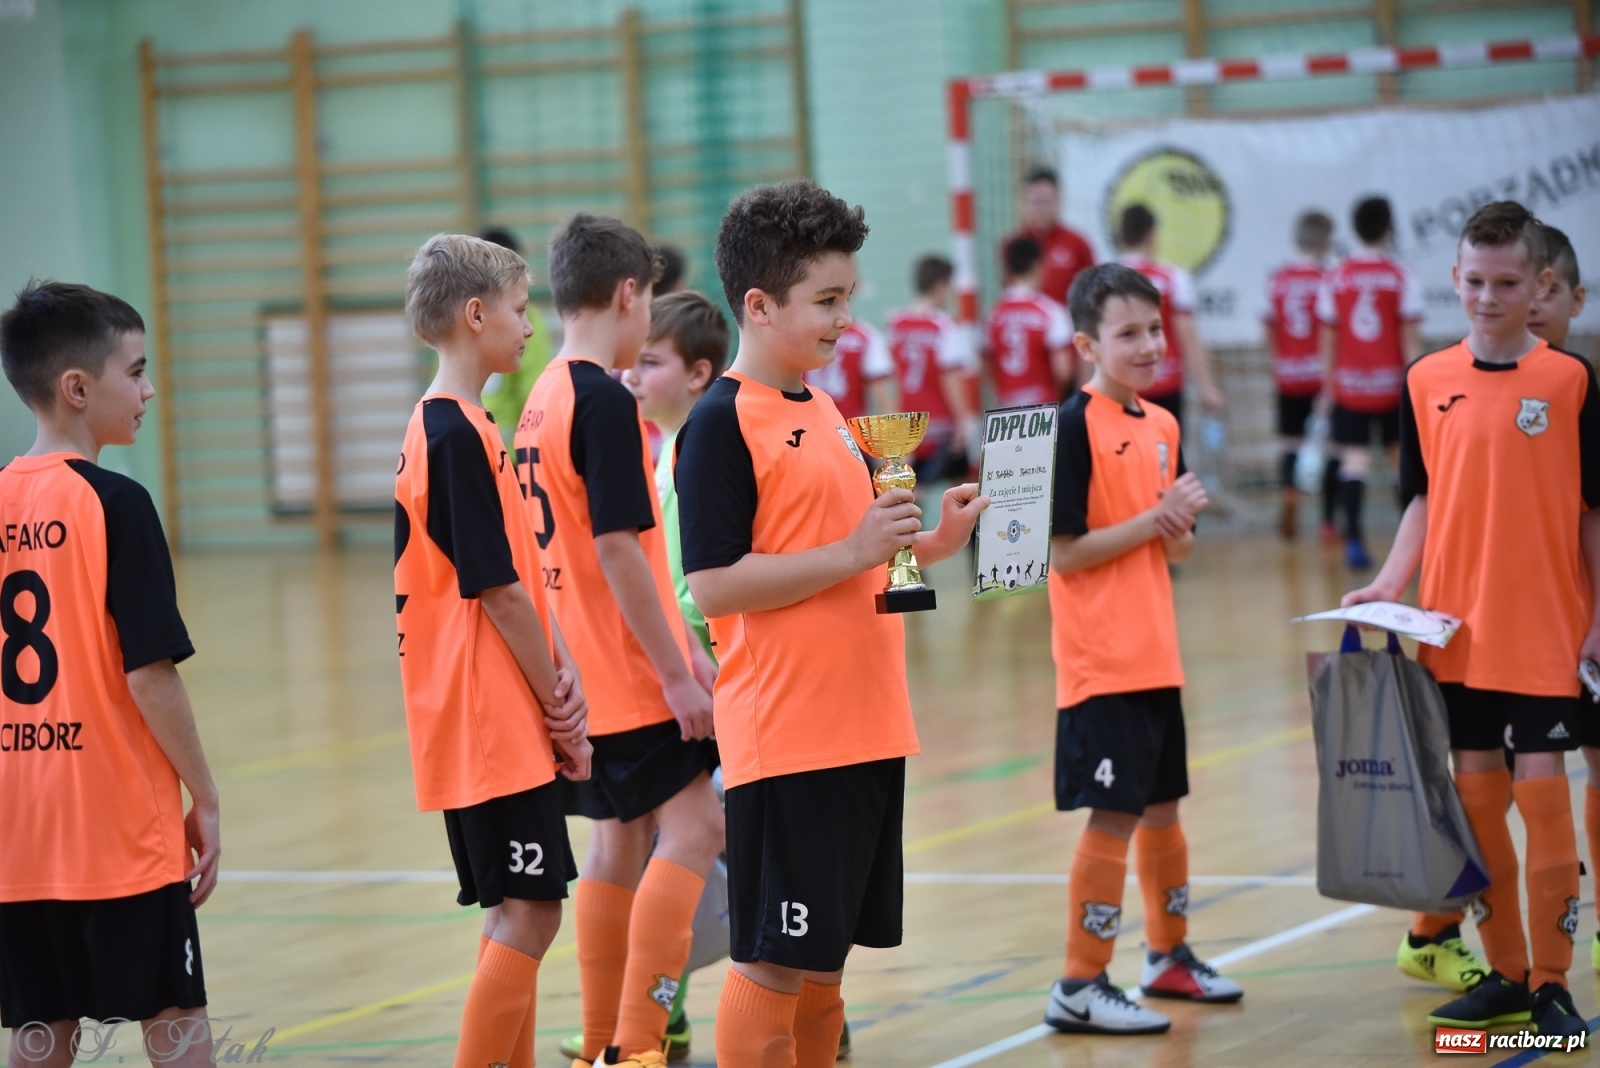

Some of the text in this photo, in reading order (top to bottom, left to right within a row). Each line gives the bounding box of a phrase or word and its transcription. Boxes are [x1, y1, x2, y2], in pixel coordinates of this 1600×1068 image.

[987, 410, 1055, 443] DYPLOM
[988, 488, 997, 497] Za
[1021, 484, 1043, 494] miejsca
[0, 569, 58, 705] 8
[1094, 757, 1115, 788] 4
[508, 840, 544, 875] 32
[781, 900, 808, 937] 13
